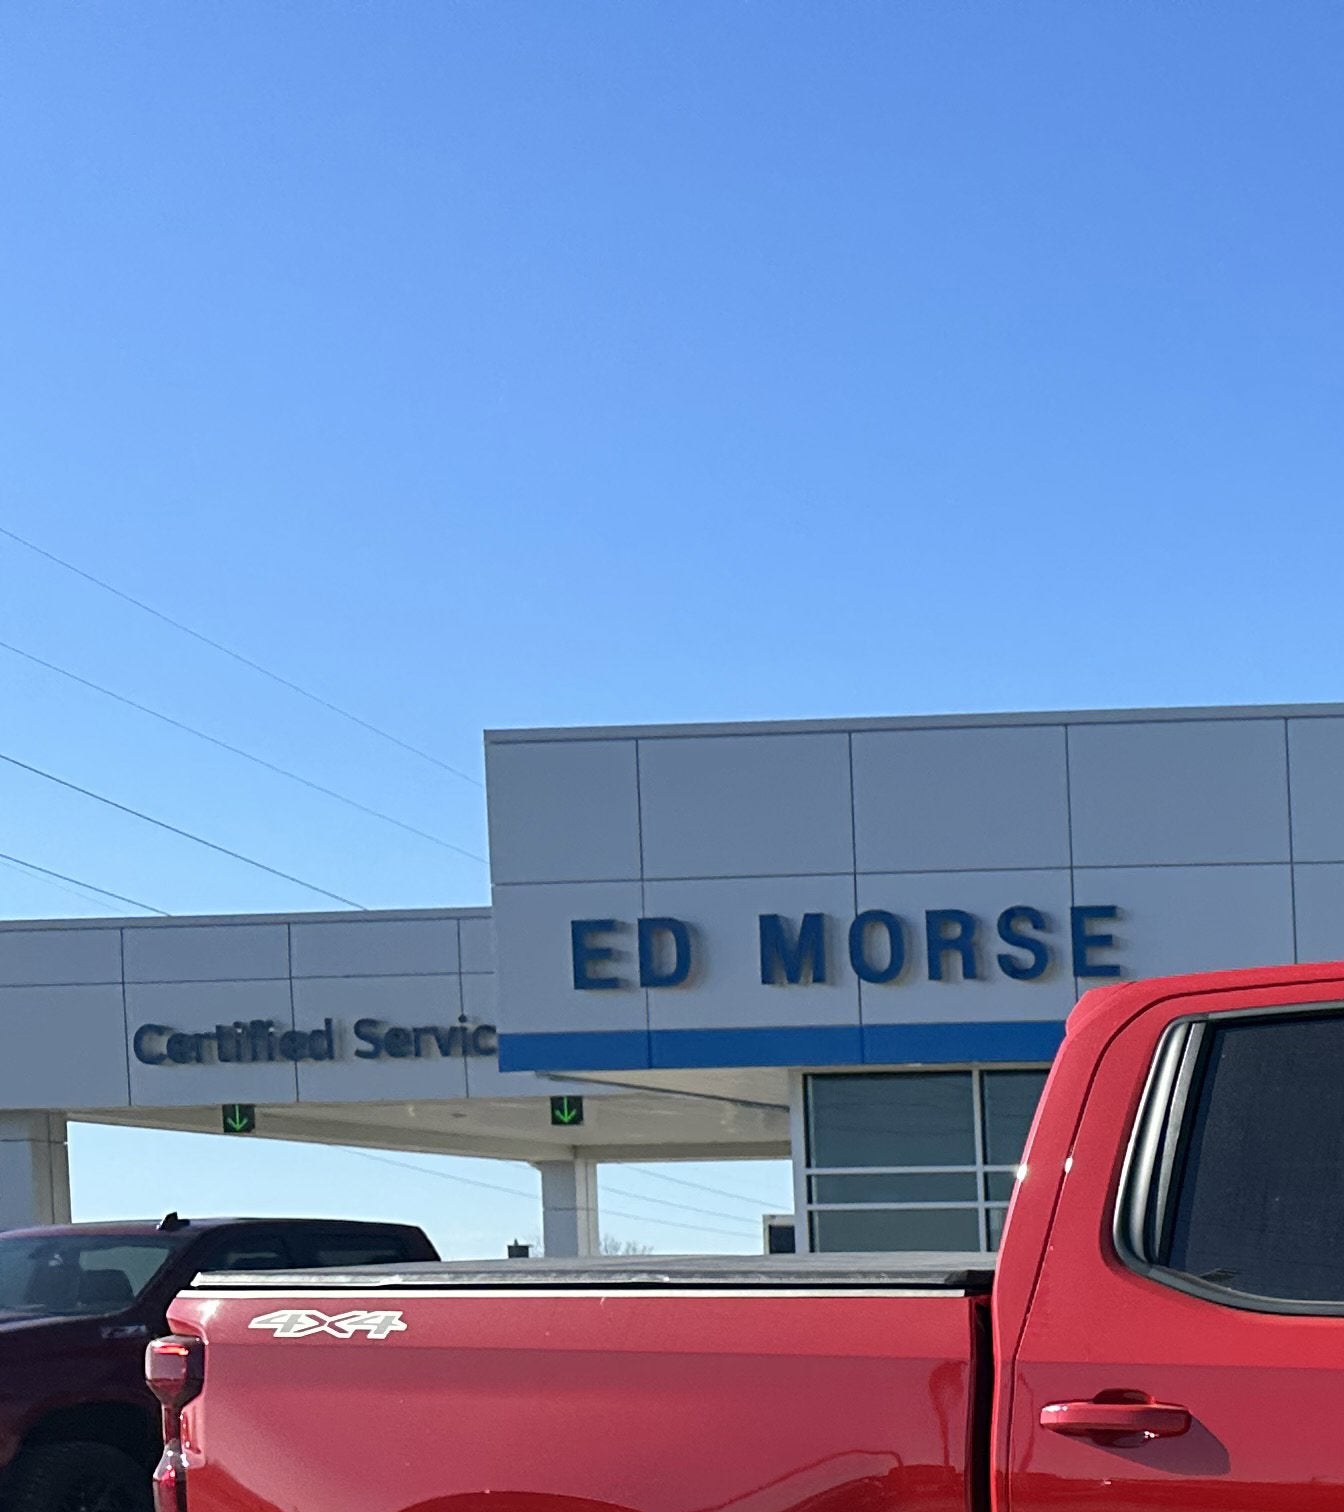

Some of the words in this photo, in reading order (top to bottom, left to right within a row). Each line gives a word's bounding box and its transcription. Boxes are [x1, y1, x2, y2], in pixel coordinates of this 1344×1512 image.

[570, 917, 694, 990] ED
[758, 904, 1122, 985] MORSE
[133, 1017, 334, 1065] Certified
[353, 1013, 497, 1059] Servic
